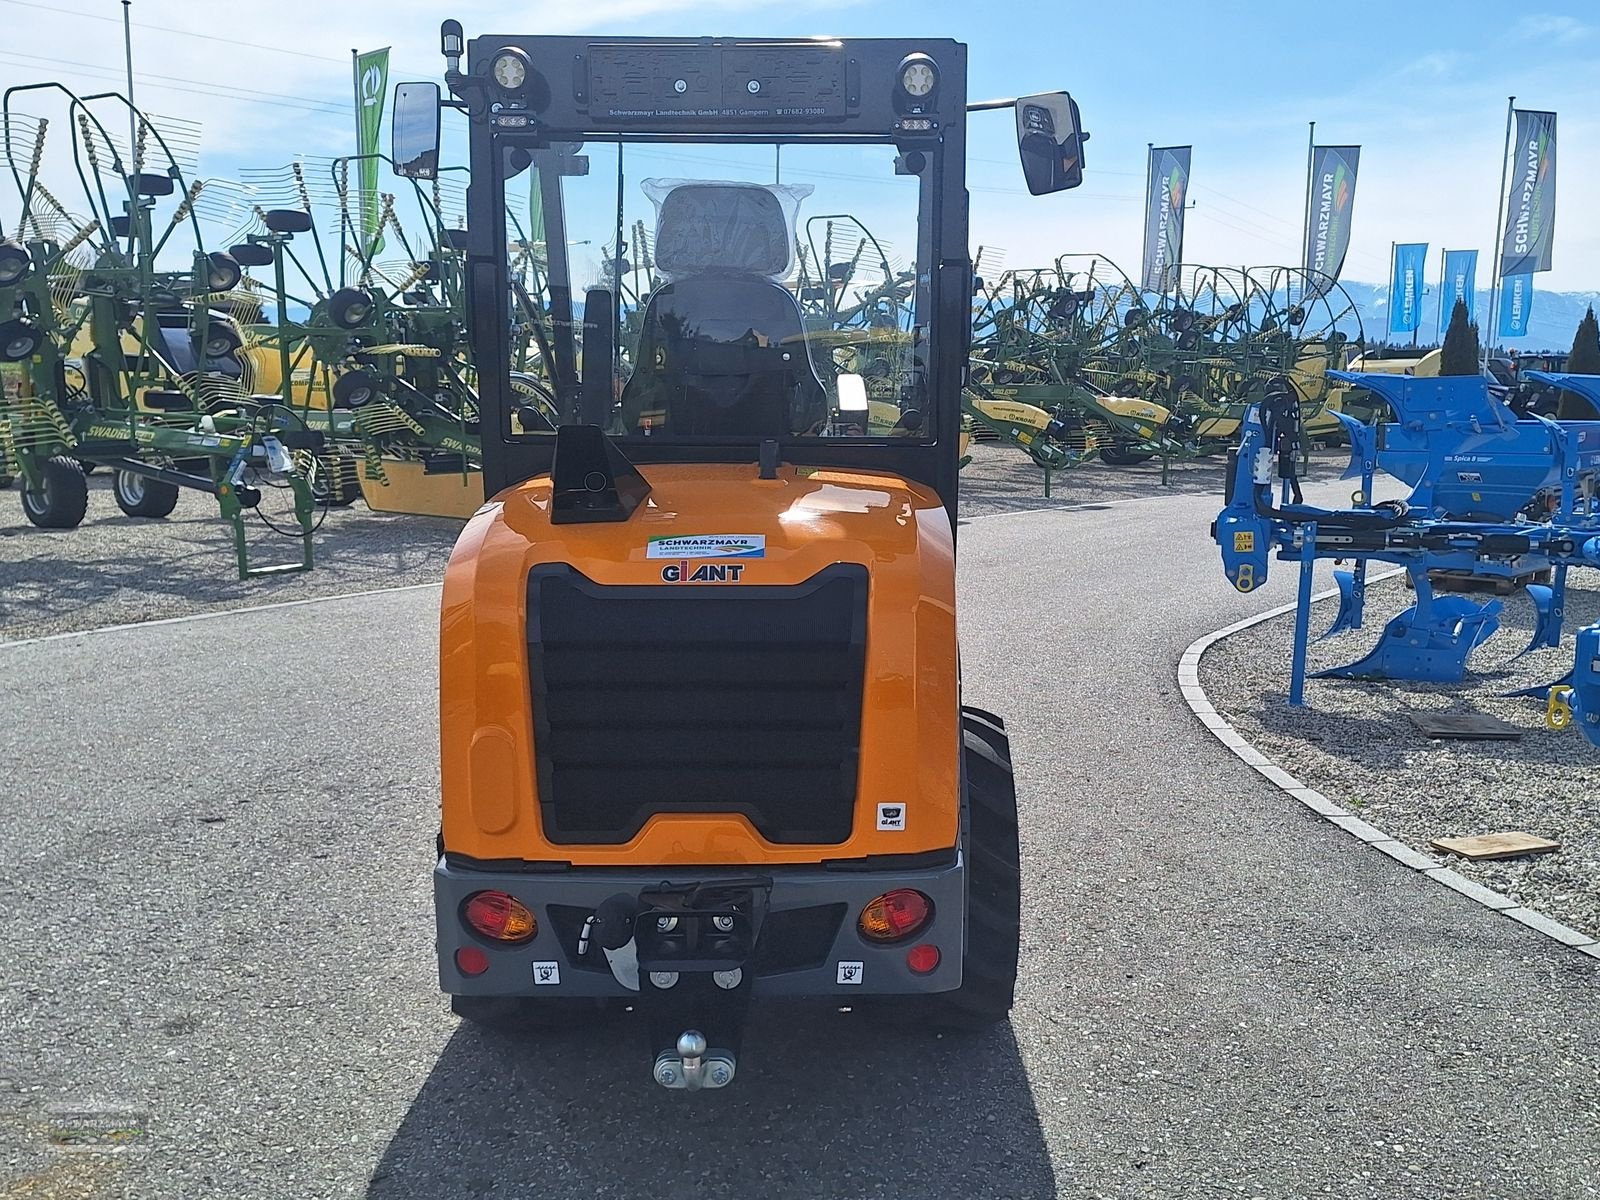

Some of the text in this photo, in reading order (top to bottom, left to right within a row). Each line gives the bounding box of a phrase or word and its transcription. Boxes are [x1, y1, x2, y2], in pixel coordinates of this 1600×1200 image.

[609, 109, 654, 117] Schwarzmayr
[1514, 139, 1539, 254] SCHWARZMAYR
[1153, 175, 1170, 275] SCHWARZMAYR
[1403, 269, 1414, 314] LEMKEN
[1512, 279, 1523, 320] LEMKEN
